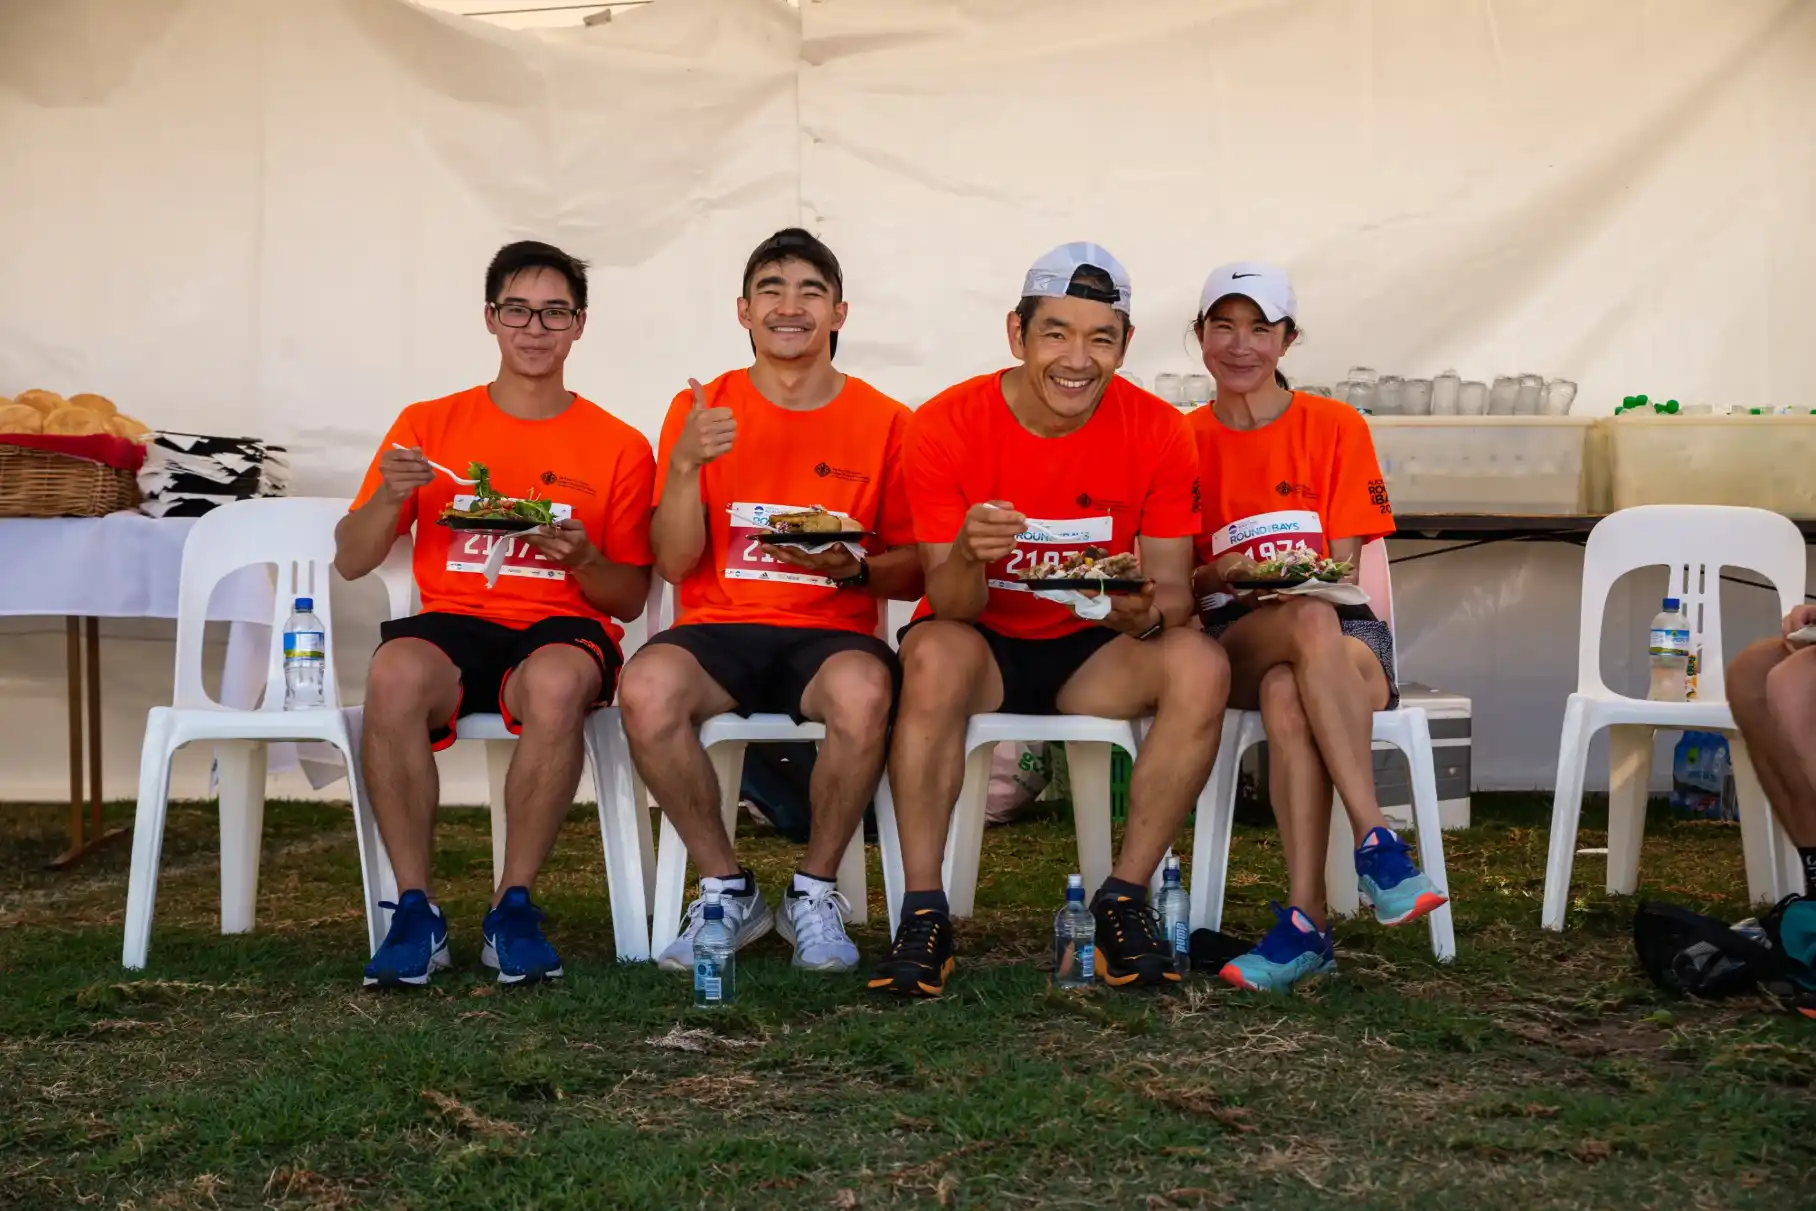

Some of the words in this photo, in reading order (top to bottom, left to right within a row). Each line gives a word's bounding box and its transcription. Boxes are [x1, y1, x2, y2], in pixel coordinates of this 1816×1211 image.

[1016, 531, 1053, 542] ROUN
[1229, 525, 1267, 544] ROUND
[1272, 522, 1300, 533] BAYS
[1175, 921, 1188, 954] pump
